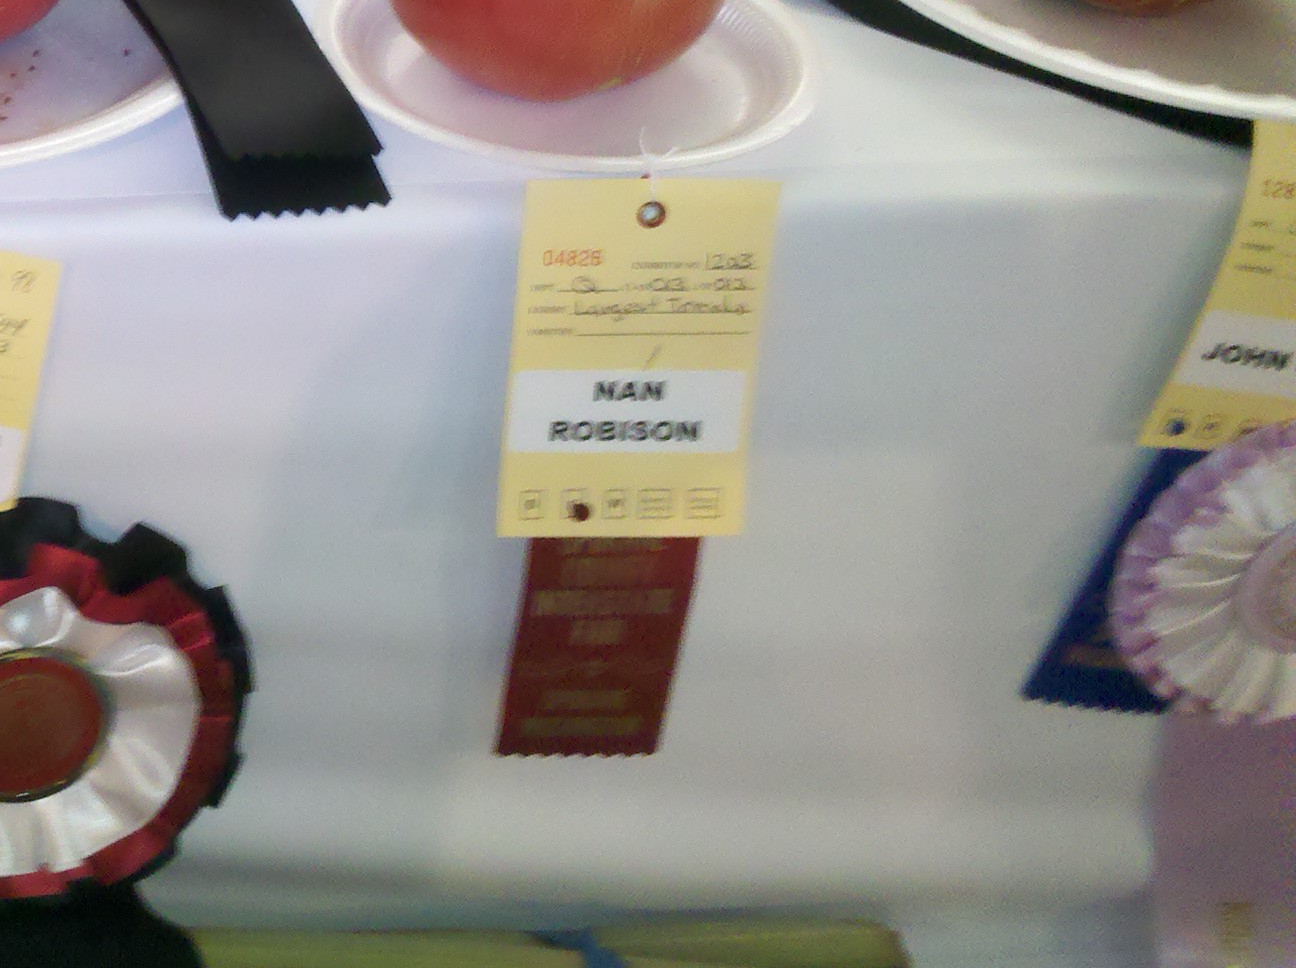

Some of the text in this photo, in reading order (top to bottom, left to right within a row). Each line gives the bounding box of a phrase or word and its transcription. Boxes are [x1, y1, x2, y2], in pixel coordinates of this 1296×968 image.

[1202, 343, 1292, 371] JOHN
[593, 381, 667, 402] NAN
[547, 420, 703, 442] ROBISON
